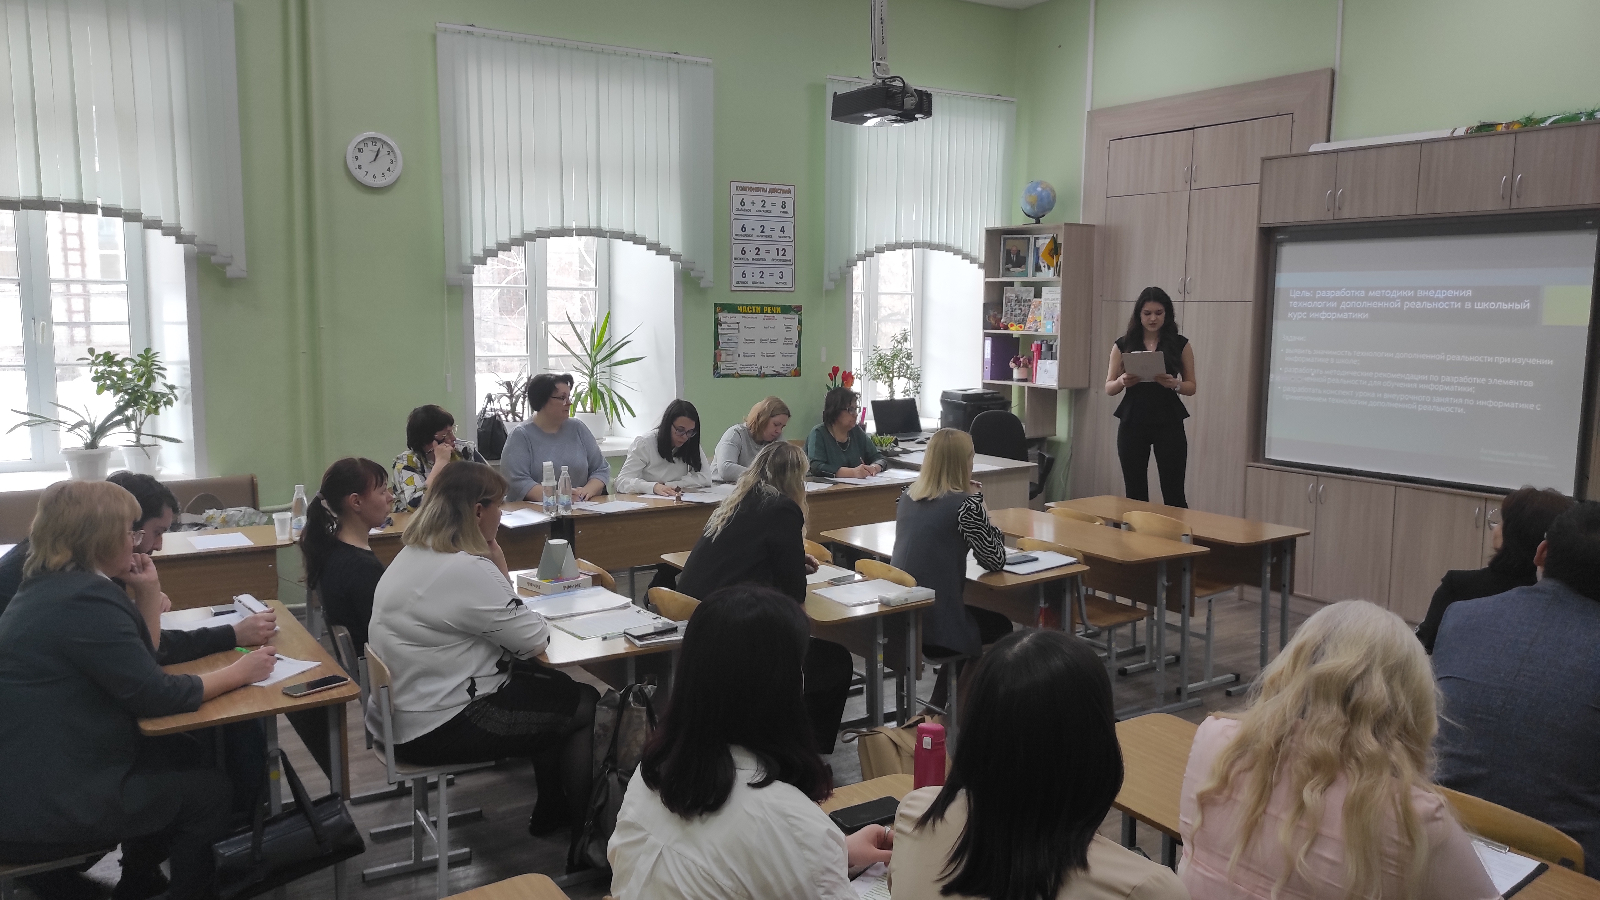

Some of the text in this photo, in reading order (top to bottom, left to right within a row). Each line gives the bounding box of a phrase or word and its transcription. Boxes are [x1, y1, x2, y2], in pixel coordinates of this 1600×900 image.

[740, 198, 745, 207] 6
[781, 201, 786, 209] 8
[741, 224, 746, 232] 6
[760, 225, 765, 233] 2
[780, 226, 785, 234] 4
[741, 247, 746, 255] 6
[755, 247, 760, 255] 2
[776, 248, 786, 256] 12
[742, 270, 746, 278] 6
[779, 271, 784, 279] 3
[1290, 288, 1472, 298] Цель: разработка методики внедрения
[1340, 300, 1400, 309] дополненной
[1404, 300, 1460, 310] реальности
[1474, 300, 1530, 310] школьный
[1288, 311, 1368, 320] курс информатики
[1395, 352, 1445, 360] дополненной
[1446, 354, 1493, 363] реальности
[1511, 357, 1553, 366] изучении
[1374, 372, 1428, 381] рекомендации
[1441, 375, 1486, 384] разработке
[1488, 378, 1534, 387] элементов
[1419, 383, 1475, 393] информатики;
[1368, 400, 1417, 409] дополненной
[1418, 404, 1466, 413] реальности.
[1384, 393, 1430, 402] внеурочного
[1432, 396, 1463, 404] занятия
[1476, 399, 1534, 410] информатике
